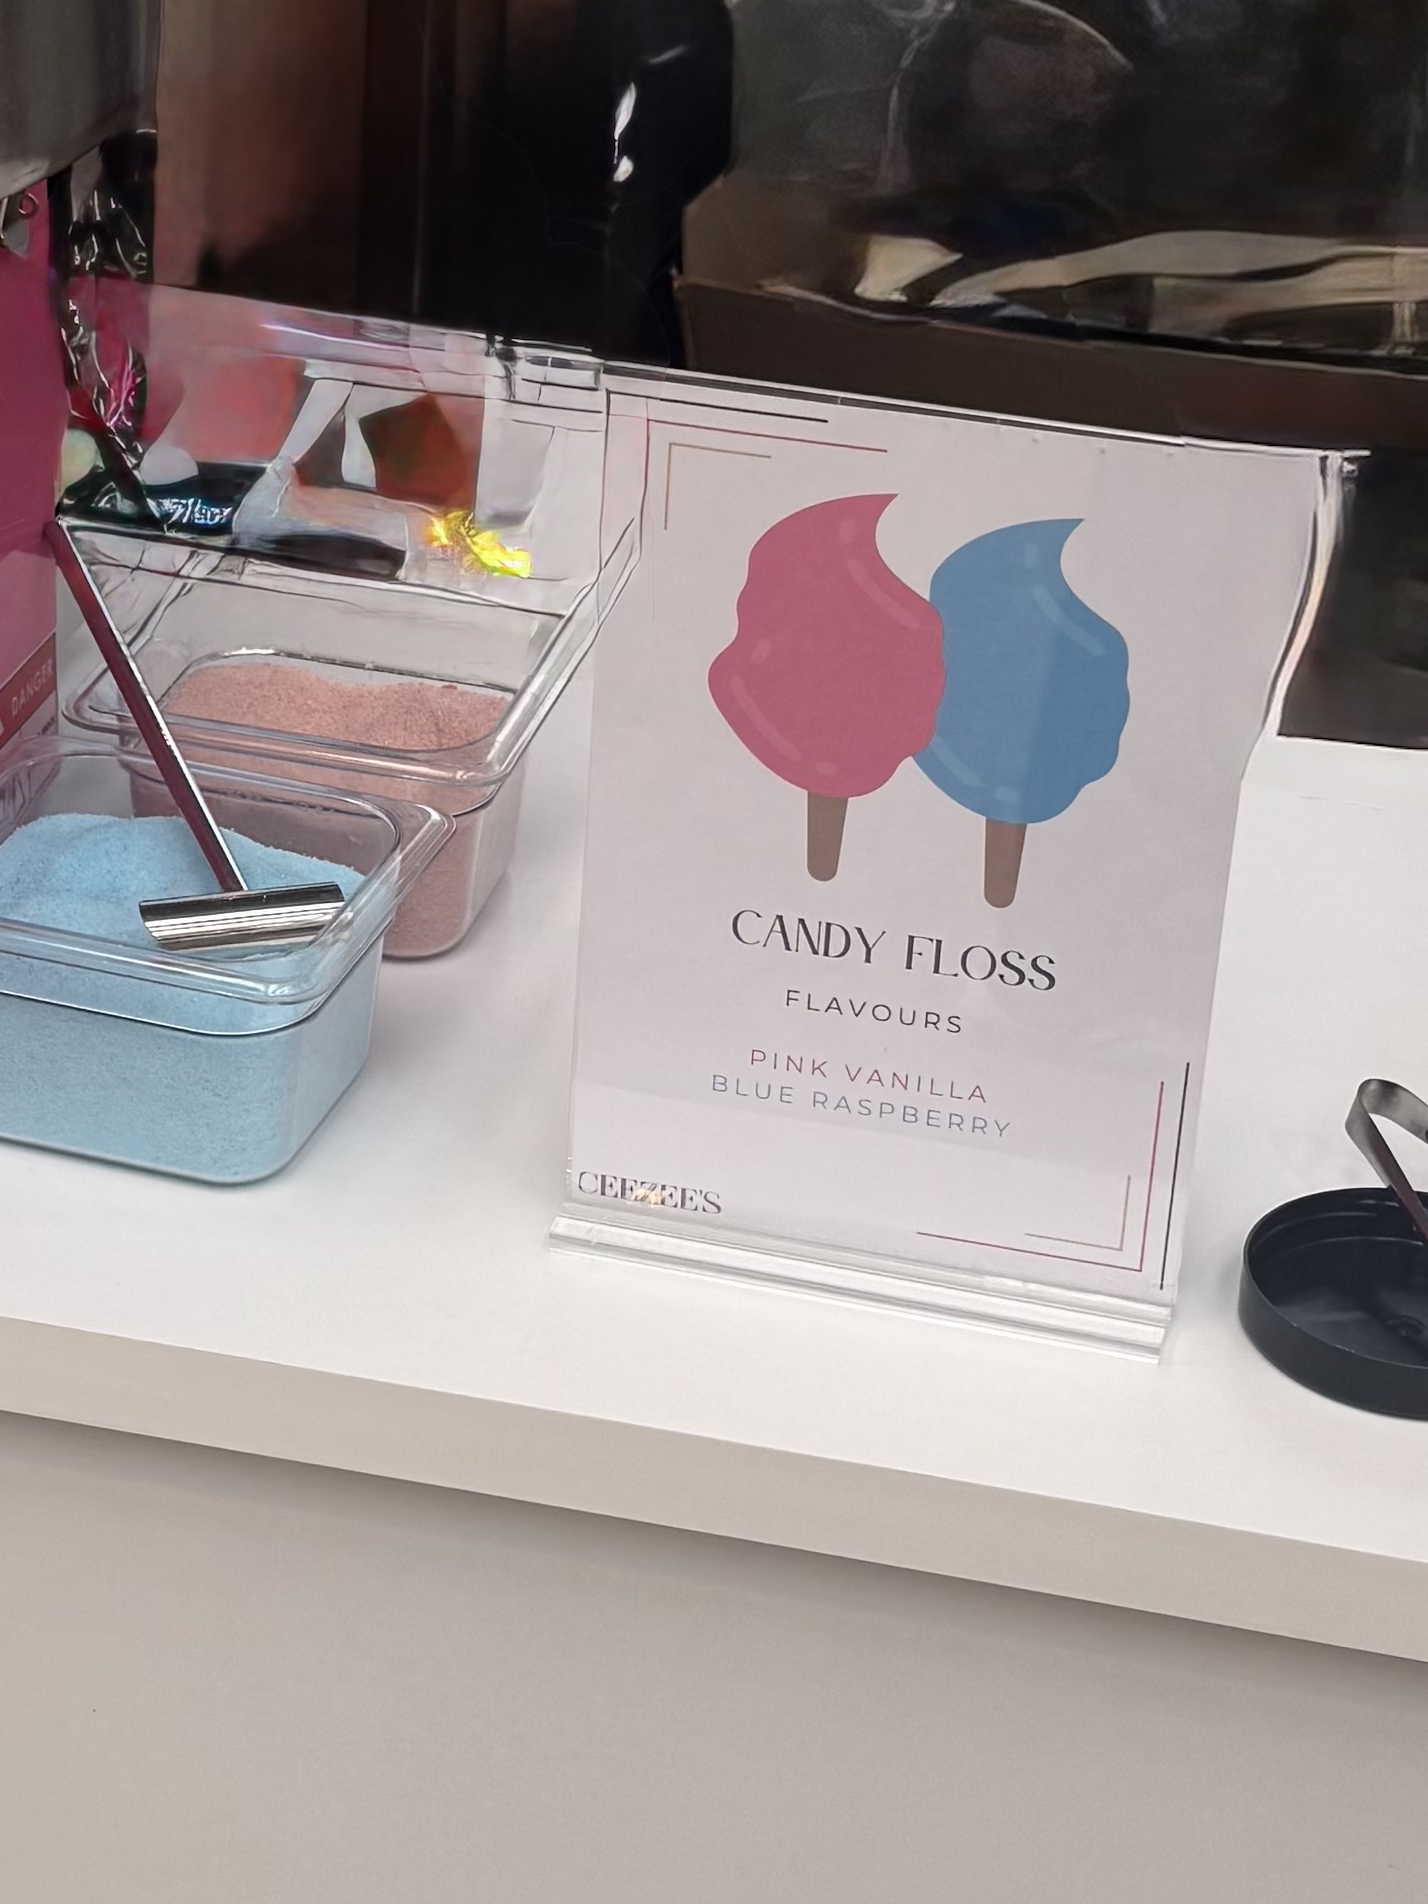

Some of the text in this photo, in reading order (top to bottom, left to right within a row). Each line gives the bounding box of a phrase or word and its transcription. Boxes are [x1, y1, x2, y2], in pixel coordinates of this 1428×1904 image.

[10, 658, 54, 718] DANGER
[731, 909, 1057, 991] CANDY FLOSS
[785, 989, 963, 1034] FLAVOURS
[711, 1074, 1011, 1137] BLUE RASPBERRY
[750, 1049, 987, 1103] PINK VANILLA
